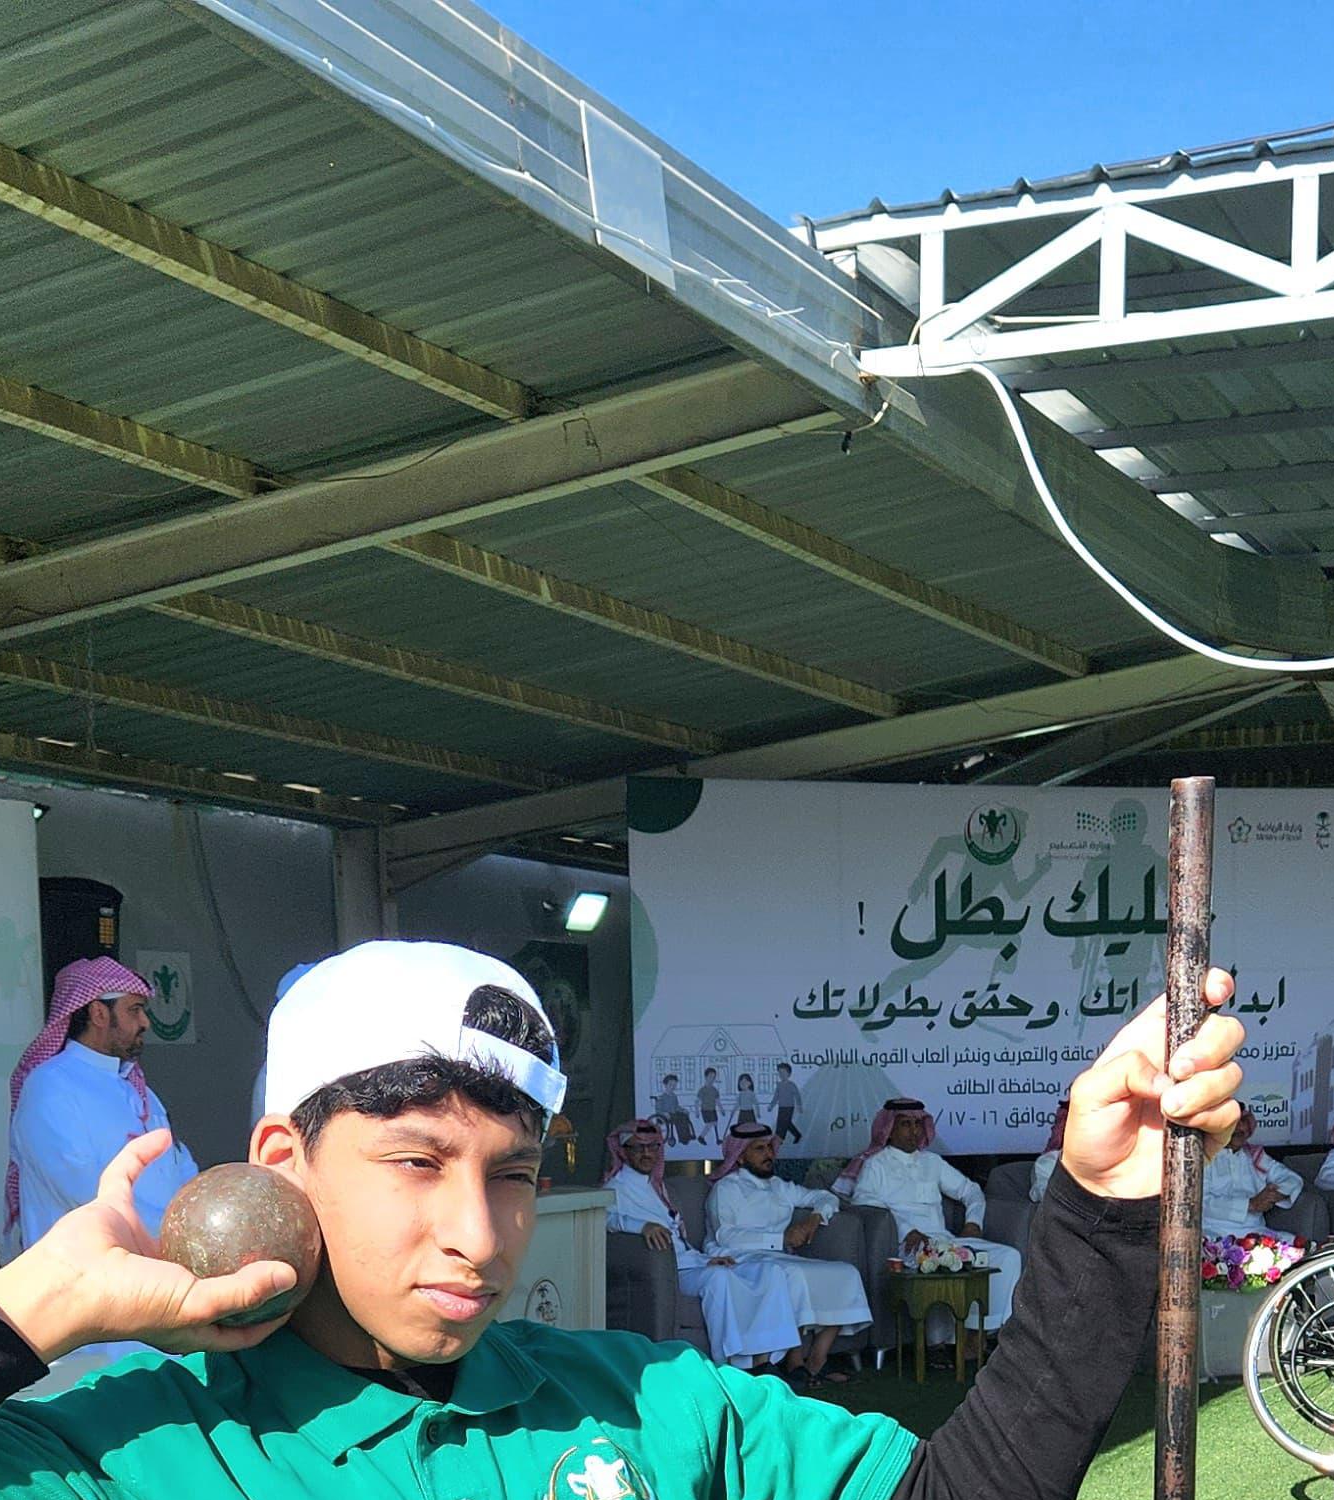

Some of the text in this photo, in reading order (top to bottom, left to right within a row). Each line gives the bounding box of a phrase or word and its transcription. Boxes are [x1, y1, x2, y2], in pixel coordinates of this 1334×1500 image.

[890, 868, 1031, 961] بطل
[1043, 864, 1169, 958] ليك
[792, 979, 944, 1032] بطولاتك
[948, 982, 1060, 1030] وحقق
[862, 1048, 908, 1070] القوى
[912, 1046, 950, 1067] ألعاب
[953, 1047, 990, 1067] ونشر
[993, 1046, 1058, 1068] والتعريف
[1262, 1041, 1297, 1061] تعزيز
[946, 1078, 994, 1096] الطائف
[998, 1078, 1061, 1096] بمحافظة
[1005, 1108, 1057, 1128] موافق
